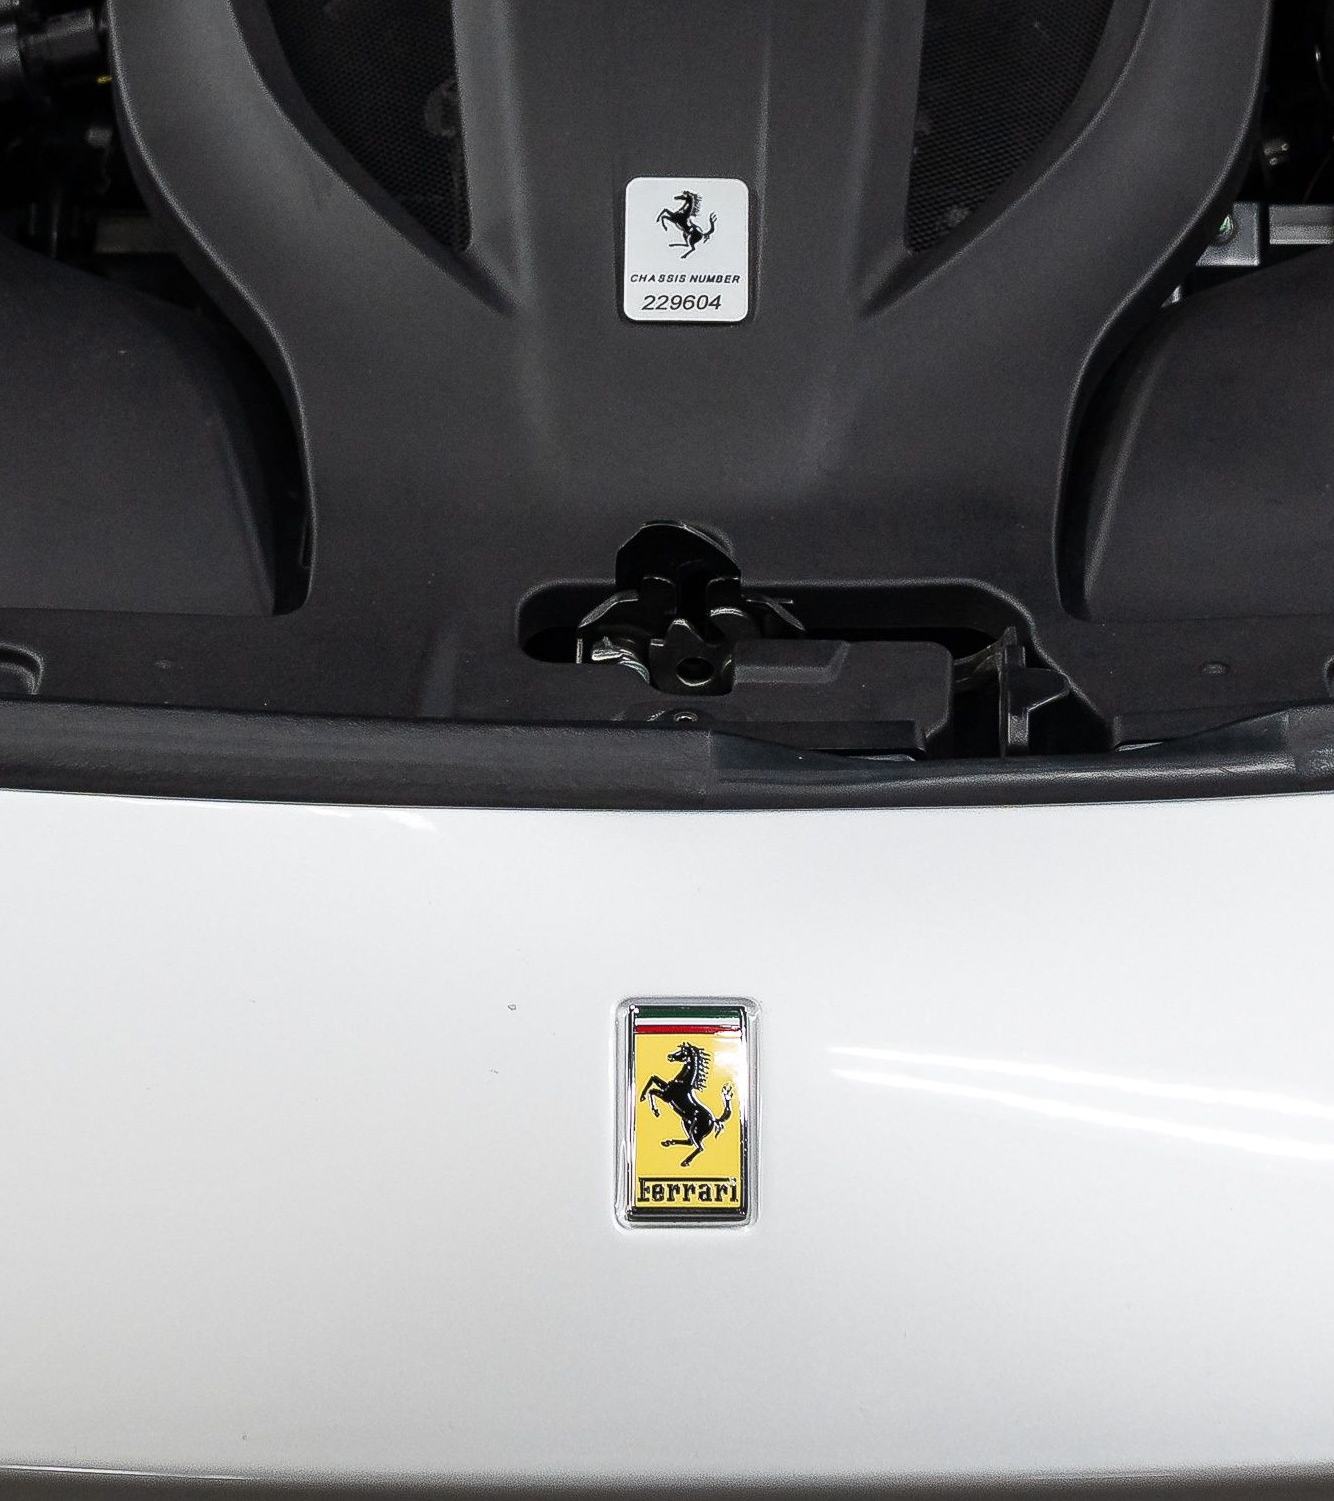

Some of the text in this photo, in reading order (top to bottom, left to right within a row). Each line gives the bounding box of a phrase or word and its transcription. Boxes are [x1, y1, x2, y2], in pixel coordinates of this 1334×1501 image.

[630, 273, 741, 284] CHASSIS NUMBER
[642, 295, 721, 310] 229604
[637, 1177, 738, 1202] Ferrari
